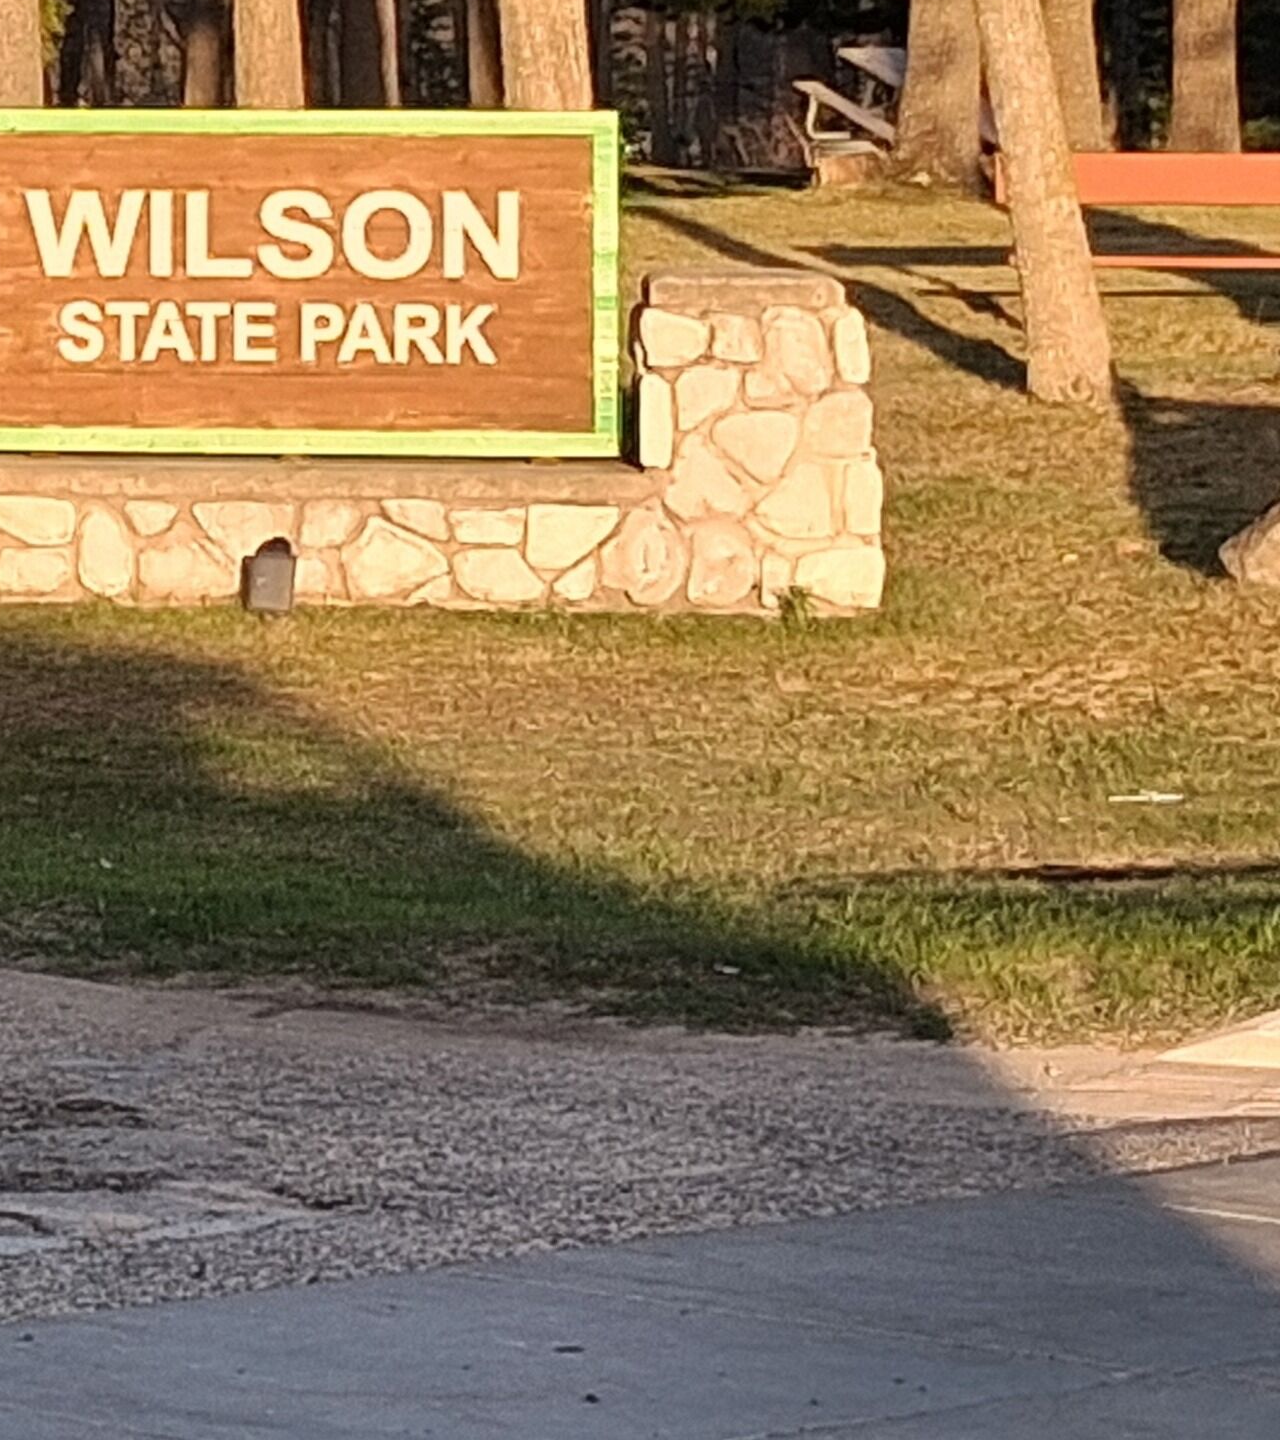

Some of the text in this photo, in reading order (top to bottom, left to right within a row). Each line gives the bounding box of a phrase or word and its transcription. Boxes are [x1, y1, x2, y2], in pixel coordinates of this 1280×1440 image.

[24, 189, 521, 280] WILSON
[56, 300, 498, 365] STATE PARK
